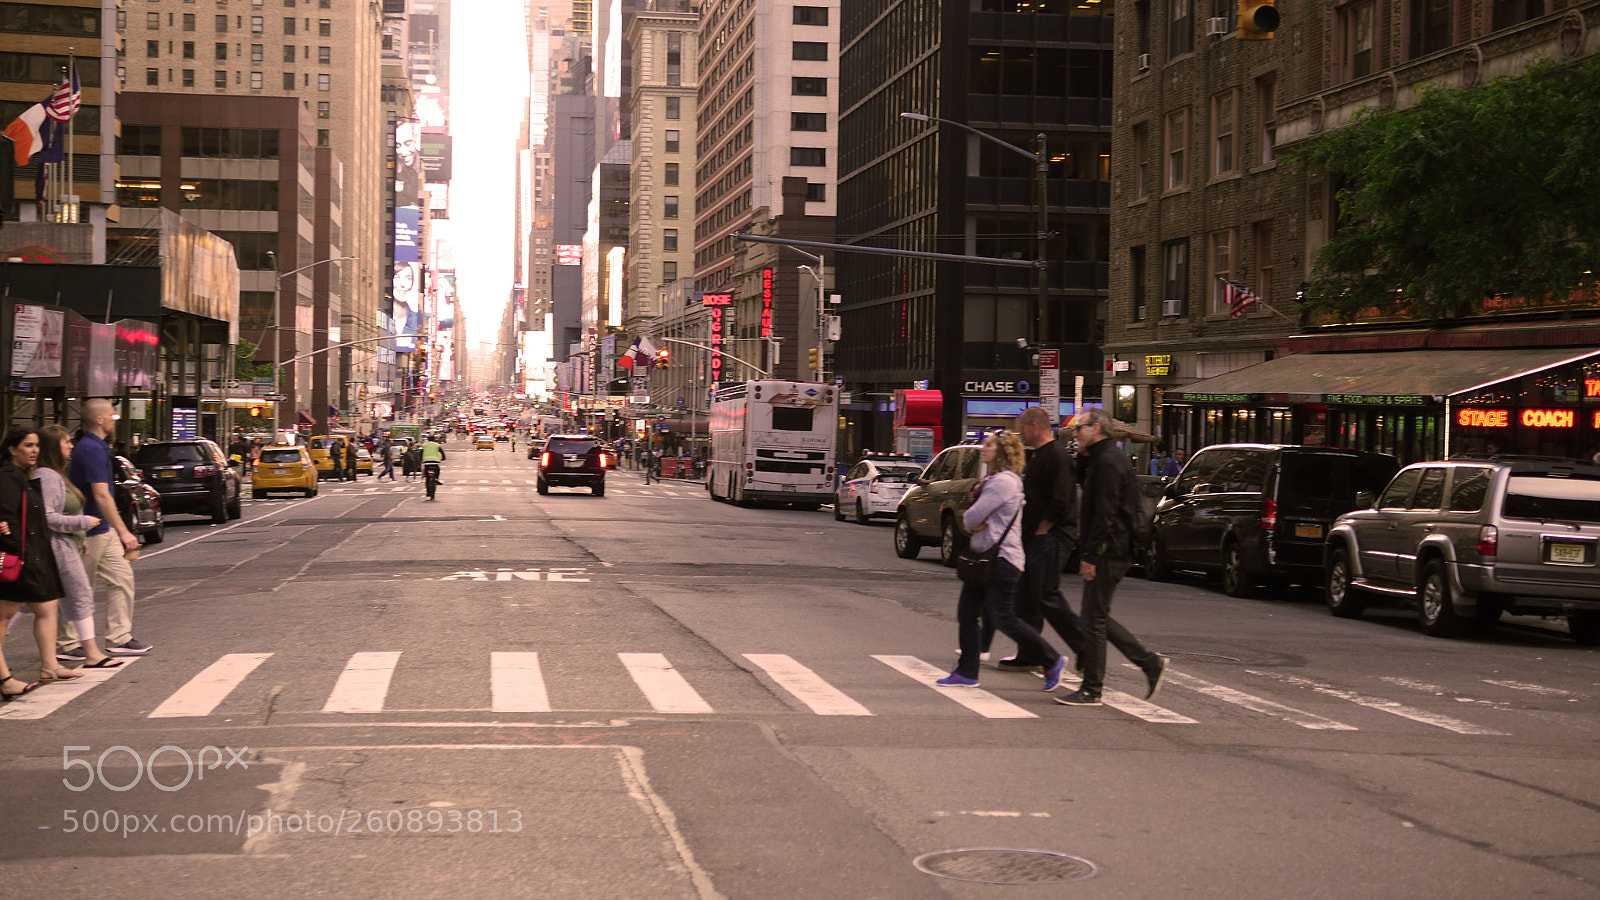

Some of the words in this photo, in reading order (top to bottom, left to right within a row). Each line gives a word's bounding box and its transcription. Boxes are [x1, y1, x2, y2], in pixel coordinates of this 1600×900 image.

[964, 381, 1014, 392] CHASE
[1458, 409, 1509, 427] STAGE
[1522, 409, 1574, 428] COACH
[423, 568, 592, 583] ANE
